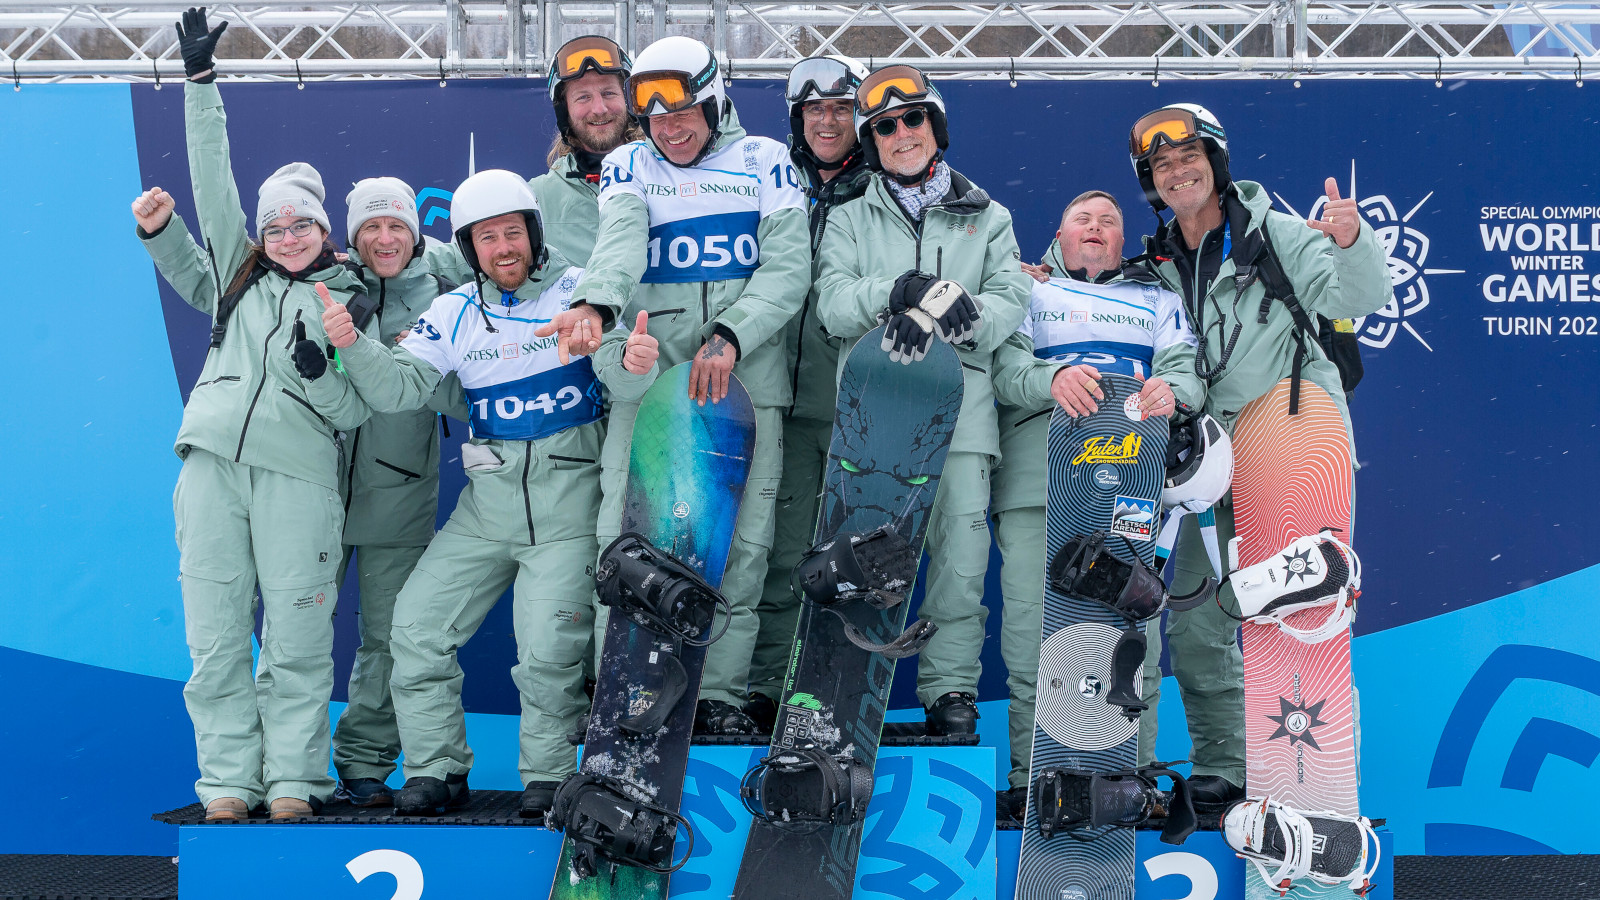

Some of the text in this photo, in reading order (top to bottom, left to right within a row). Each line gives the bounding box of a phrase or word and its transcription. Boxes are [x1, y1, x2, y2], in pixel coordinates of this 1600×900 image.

[1201, 122, 1225, 138] HEAD
[1480, 206, 1540, 220] SPECIAL
[648, 233, 759, 269] 1050
[1510, 255, 1584, 271] WINTER
[1091, 312, 1154, 332] SANPAOLO
[1482, 316, 1599, 336] TURIN 202
[521, 335, 559, 356] SANPA
[473, 385, 583, 420] 1049
[1072, 434, 1122, 466] Julen
[1113, 524, 1141, 534] ARENA
[1114, 518, 1150, 530] ALETSCH
[1293, 671, 1301, 704] NITRO
[1296, 742, 1304, 784] VOLCOM
